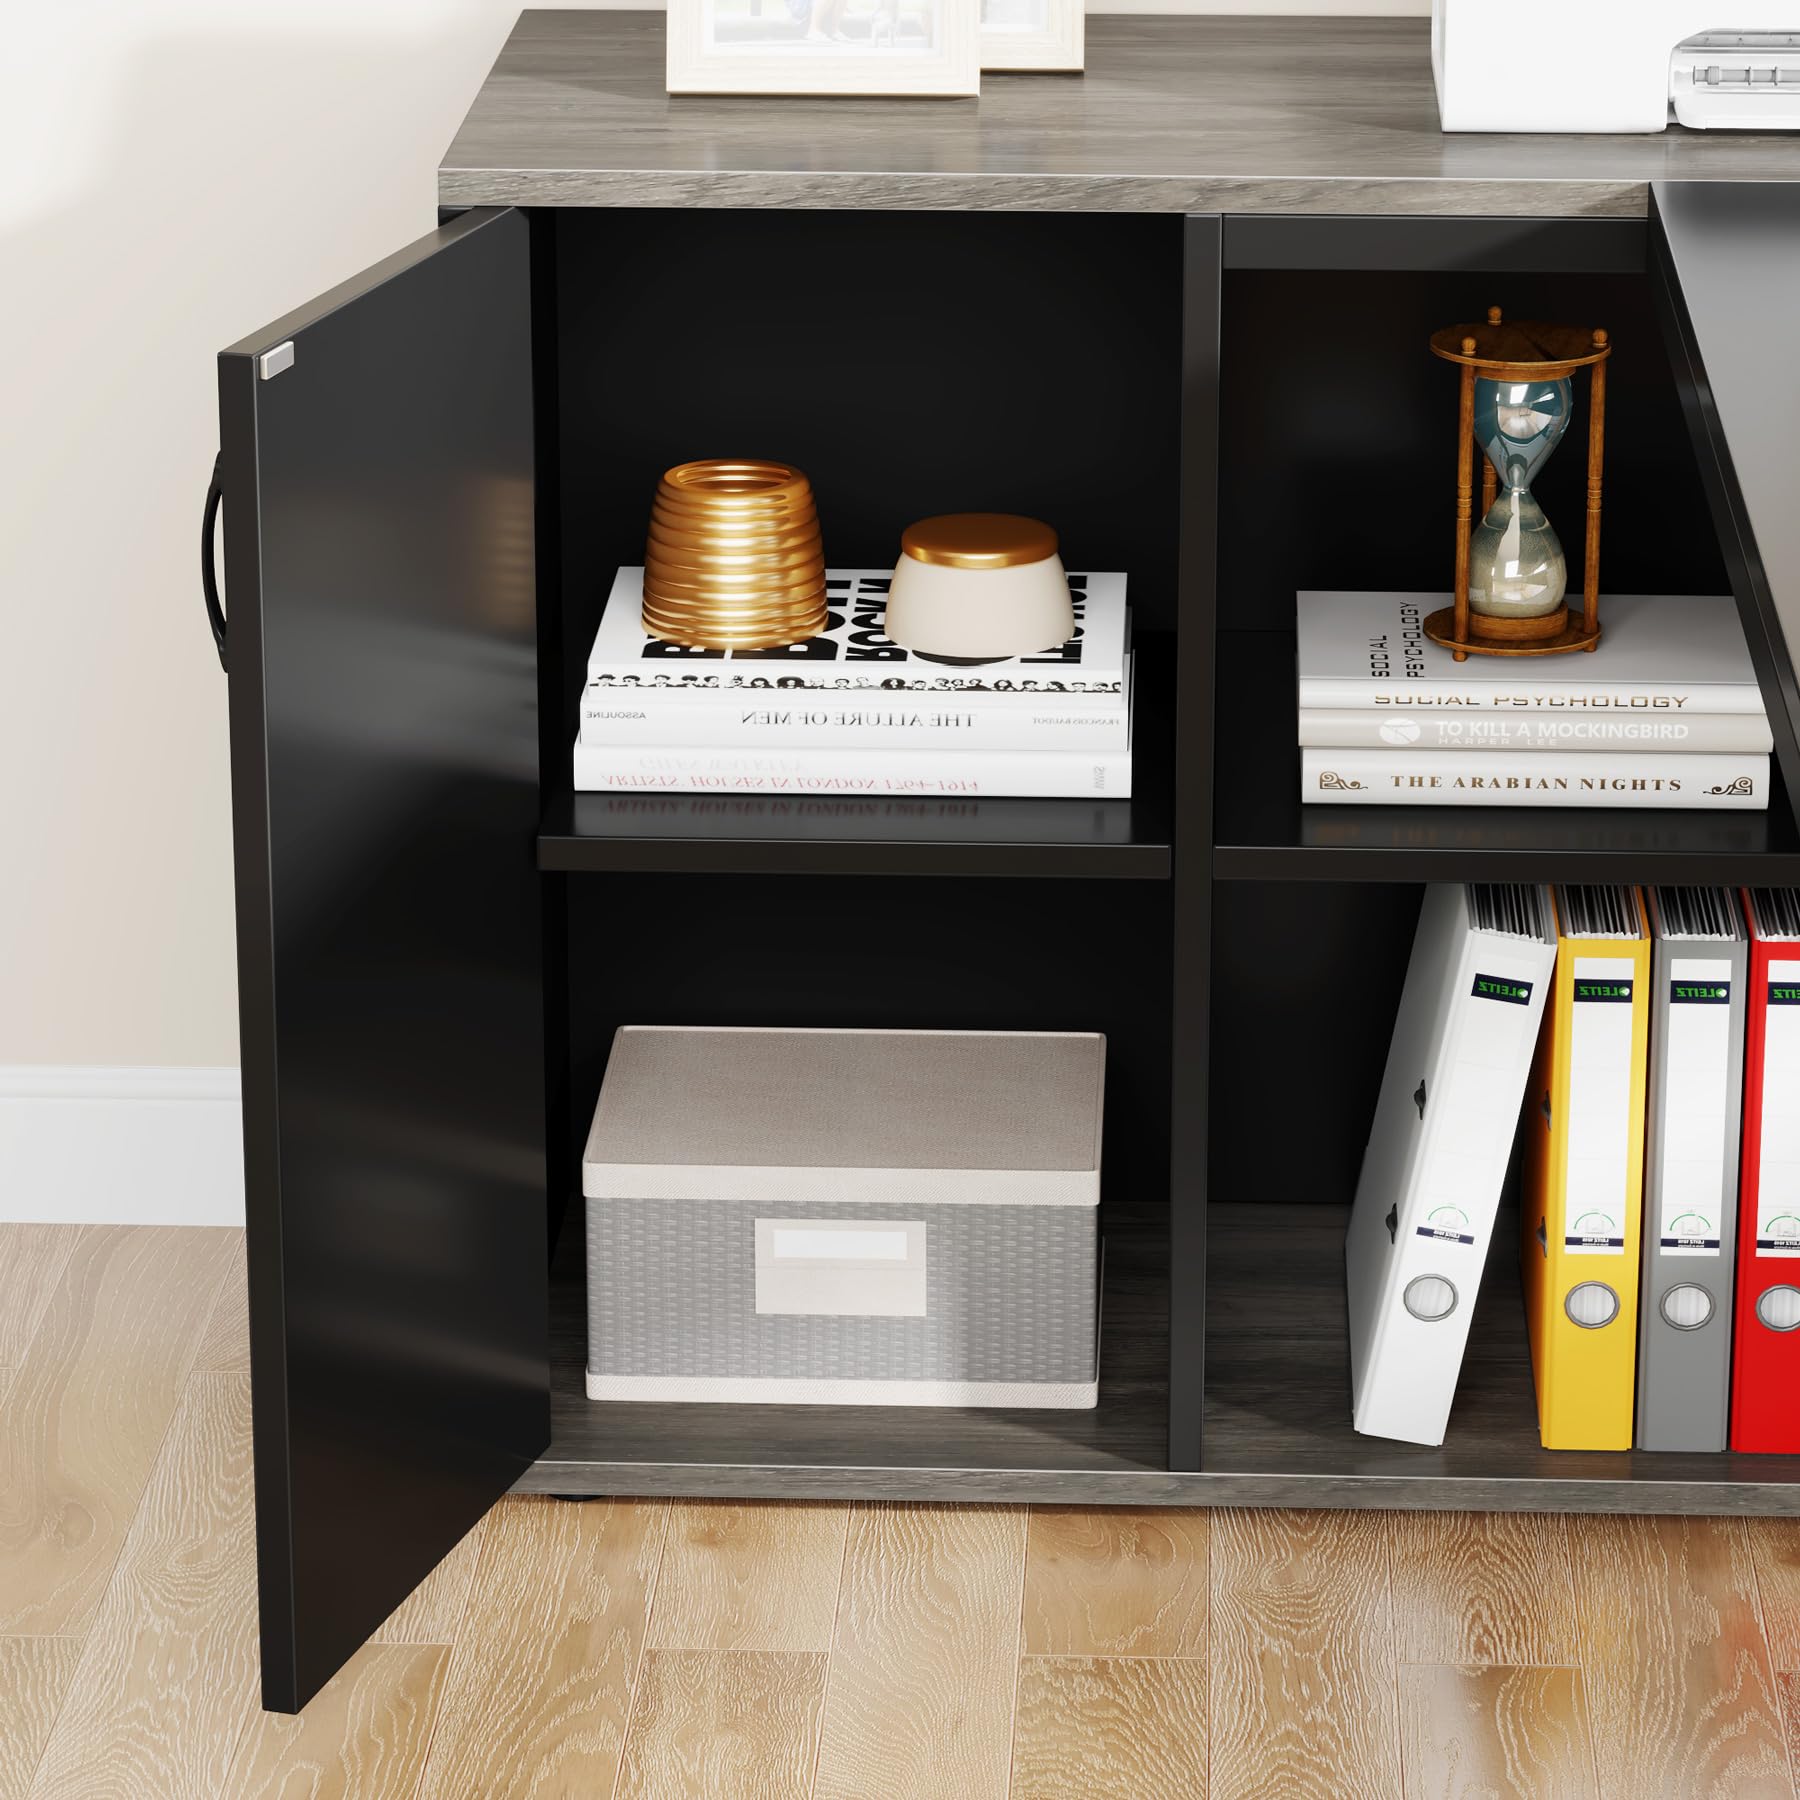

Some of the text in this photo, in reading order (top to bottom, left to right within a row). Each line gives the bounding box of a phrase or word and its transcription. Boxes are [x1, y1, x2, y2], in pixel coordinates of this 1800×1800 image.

[1400, 601, 1425, 678] PSYCHOLOGY
[1369, 634, 1390, 678] SOCIAL
[1375, 695, 1689, 708] SOCIAL PSYCHOLOGY
[1435, 720, 1689, 740] TO KILL A MOCKINGBIRD
[1438, 737, 1558, 746] HARPER LEE
[1391, 775, 1681, 791] THE ARABIAN NIGHTS
